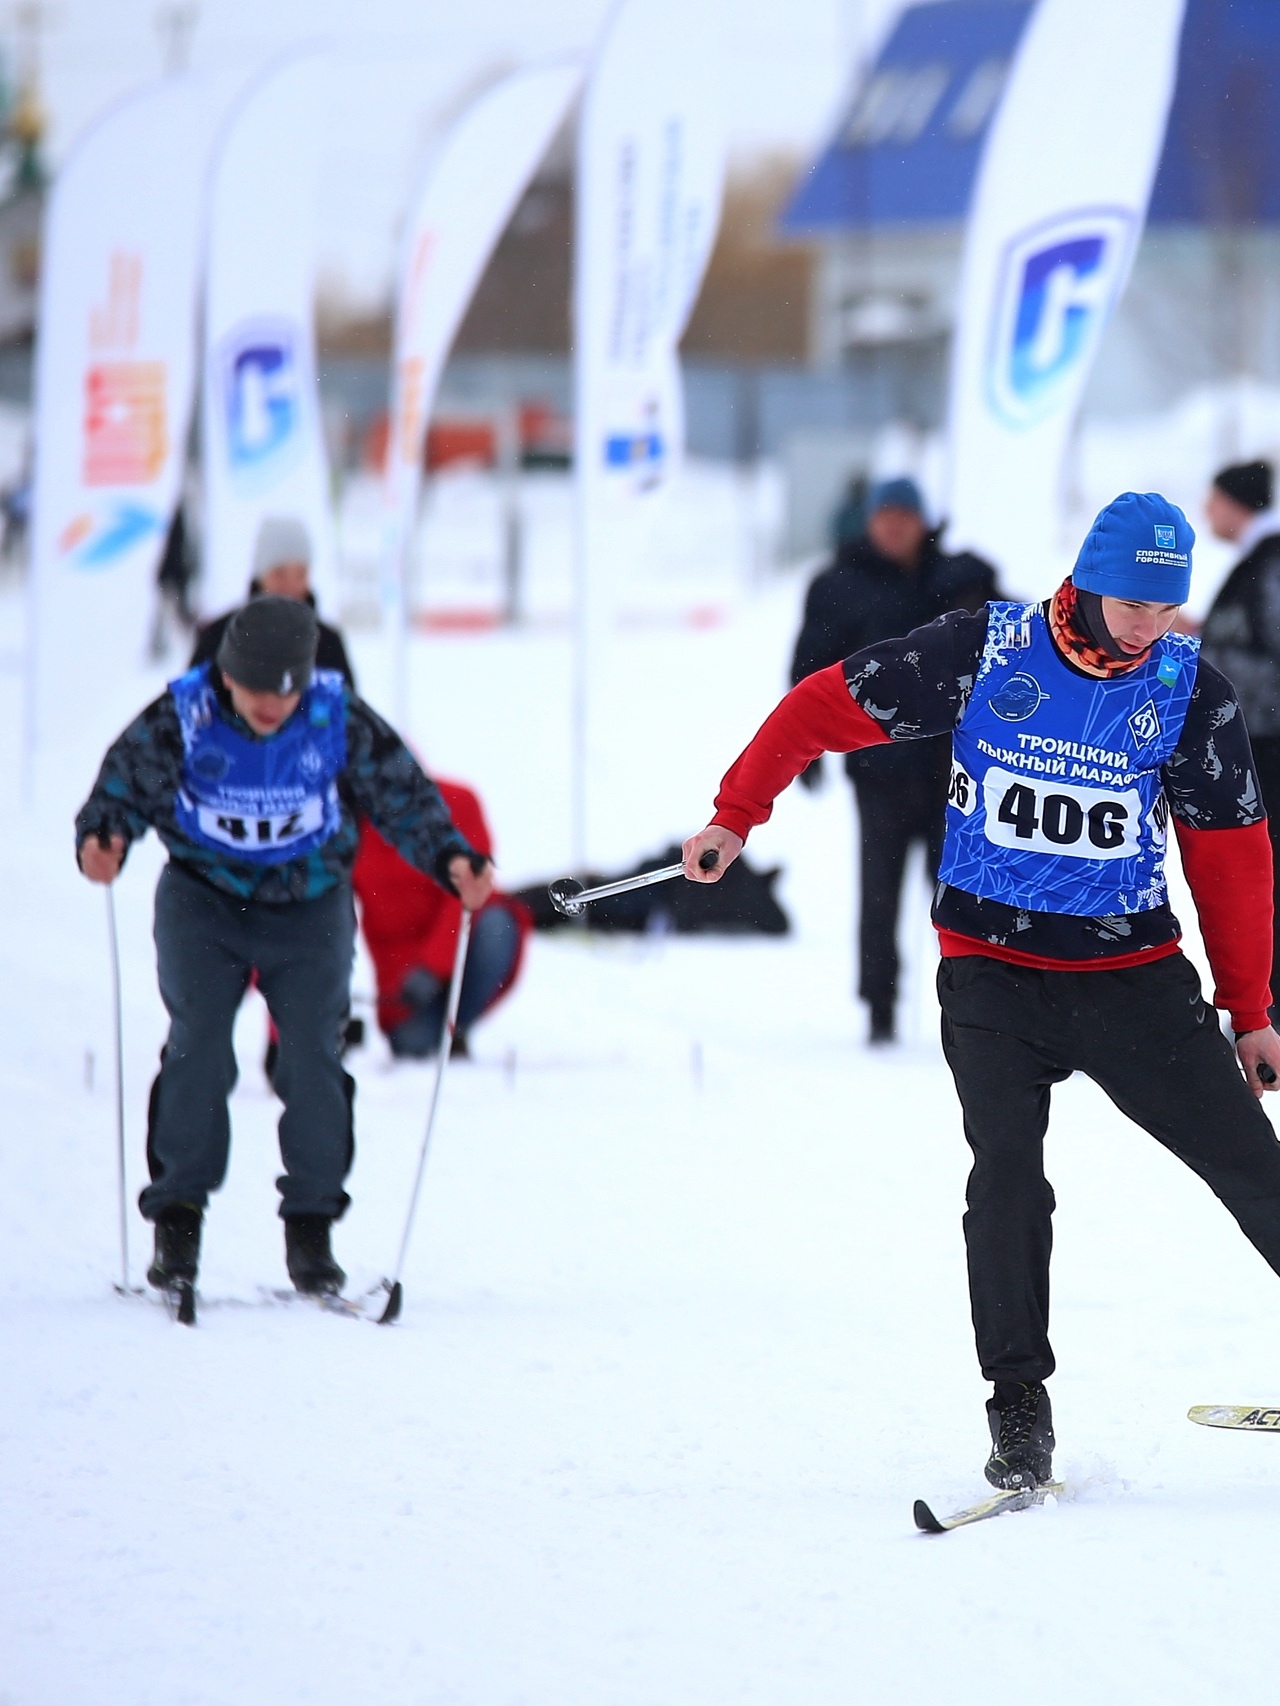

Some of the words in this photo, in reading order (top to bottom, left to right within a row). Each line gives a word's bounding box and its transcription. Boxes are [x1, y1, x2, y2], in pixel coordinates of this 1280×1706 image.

[1135, 556, 1166, 565] ГОРОД
[1136, 550, 1188, 561] СПОРТИВНЫЙ
[976, 738, 1066, 776] ЛЫЖНЫЙ
[1070, 763, 1156, 787] МАРАФ
[1017, 733, 1129, 770] ТРОИЦКИЙ
[217, 812, 305, 841] 412
[997, 781, 1129, 849] 406
